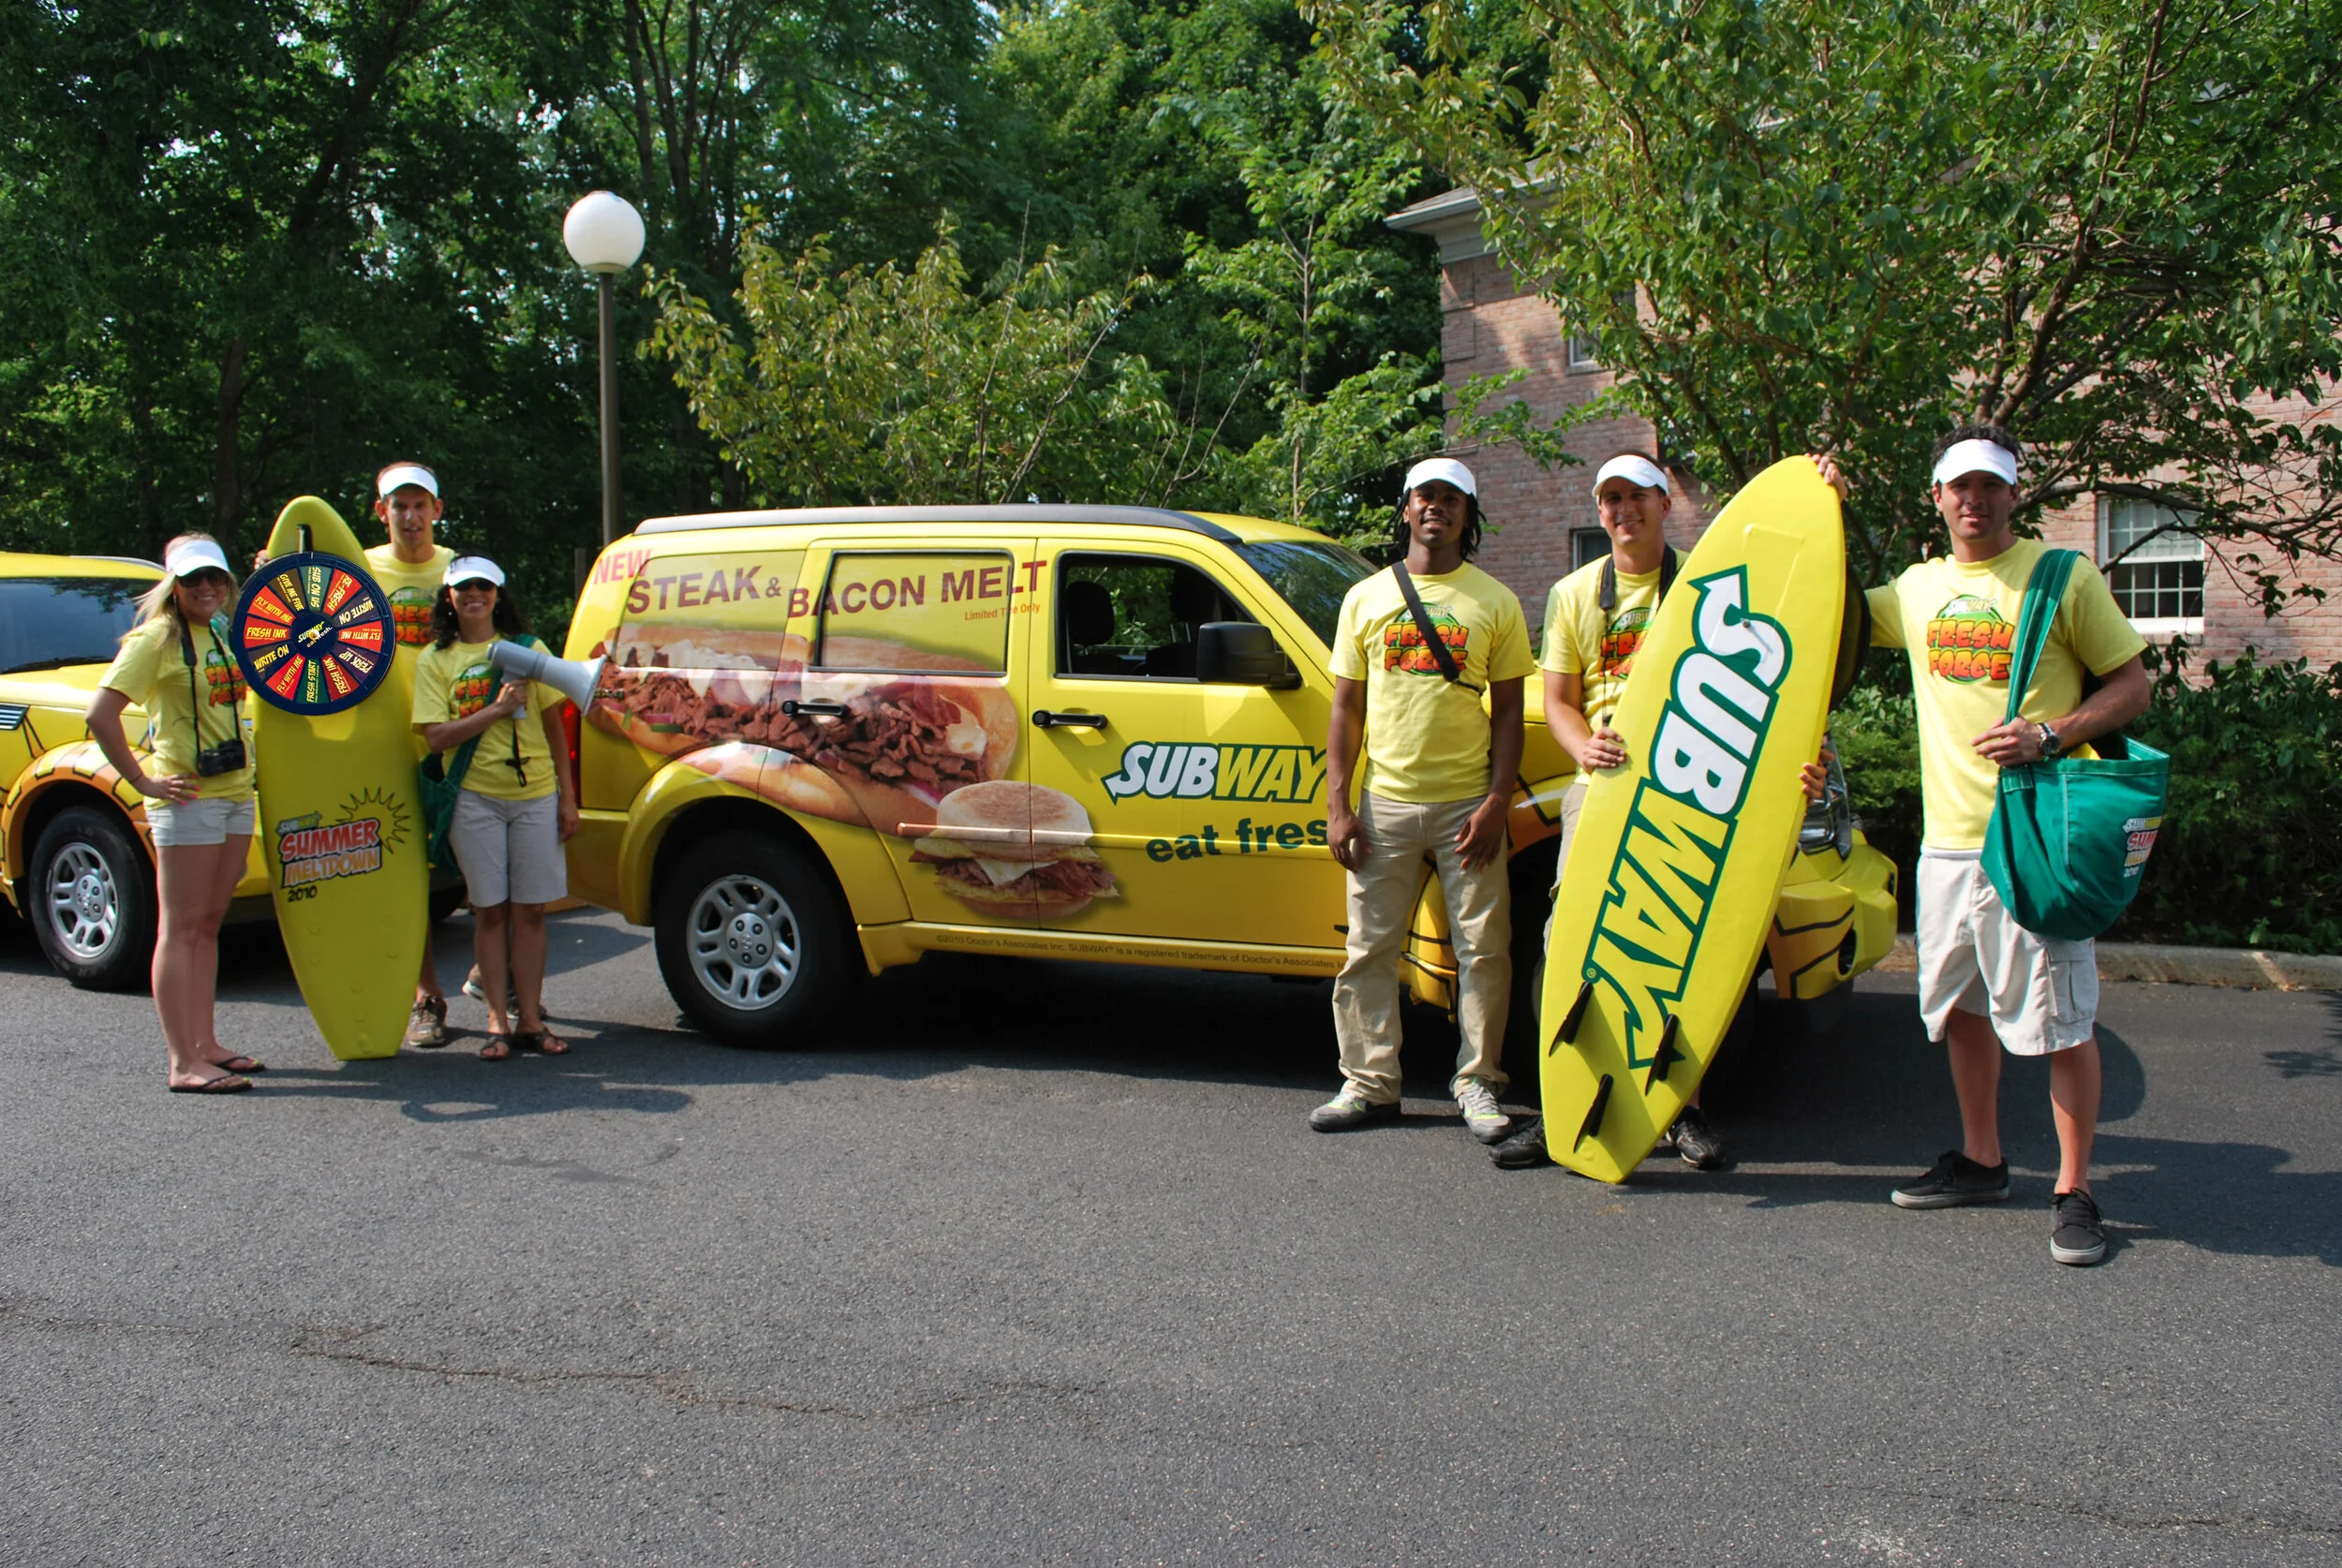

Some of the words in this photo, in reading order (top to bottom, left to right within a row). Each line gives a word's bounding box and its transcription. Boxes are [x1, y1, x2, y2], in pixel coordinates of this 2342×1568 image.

[311, 567, 321, 583] SUB
[594, 549, 652, 584] NEW
[279, 573, 292, 588] GIVE
[311, 584, 321, 596] ON
[628, 565, 763, 614] STEAK
[764, 576, 782, 599] &
[788, 575, 926, 618] BACON
[941, 560, 1047, 603] MELT
[287, 587, 298, 598] ME
[310, 597, 320, 608] US
[327, 574, 353, 612] RE-FRESH
[255, 596, 268, 606] FLY
[266, 603, 283, 616] WITH
[280, 613, 293, 623] ME
[292, 598, 305, 611] FIVE
[350, 599, 374, 618] WRITE
[392, 604, 434, 624] RES
[965, 609, 998, 621] Limited
[338, 611, 351, 626] ON
[245, 628, 272, 637] FRESH
[273, 629, 287, 639] INK
[352, 631, 369, 640] WITH
[395, 624, 434, 643] ORC
[1601, 629, 1649, 658] FRE
[1926, 618, 2015, 651] FRESH
[253, 650, 277, 671] WRITE
[277, 644, 289, 658] ON
[323, 658, 337, 672] INK
[338, 650, 354, 661] UP
[350, 656, 373, 673] PERK
[1385, 647, 1469, 672] FORE
[1928, 648, 2013, 681] FORCE
[276, 680, 287, 693] FLY
[283, 665, 296, 683] WITH
[293, 656, 304, 669] ME
[307, 659, 317, 682] START
[330, 671, 349, 695] FRESH
[455, 676, 493, 700] FRE
[1103, 742, 1327, 805] SUBWAY
[1583, 564, 1792, 1069] SUBWAY
[280, 819, 378, 862] SUMMER
[1146, 824, 1222, 863] eat
[1236, 818, 1329, 853] fres
[2127, 830, 2158, 851] SUM
[285, 848, 379, 886] MELTDOWN
[288, 886, 318, 902] 2010
[1002, 939, 1047, 950] Associates
[1134, 948, 1178, 959] registered
[1181, 951, 1228, 962] trademark
[1231, 954, 1239, 963] of
[1242, 955, 1282, 965] Doctor's
[1282, 957, 1335, 969] Associates
